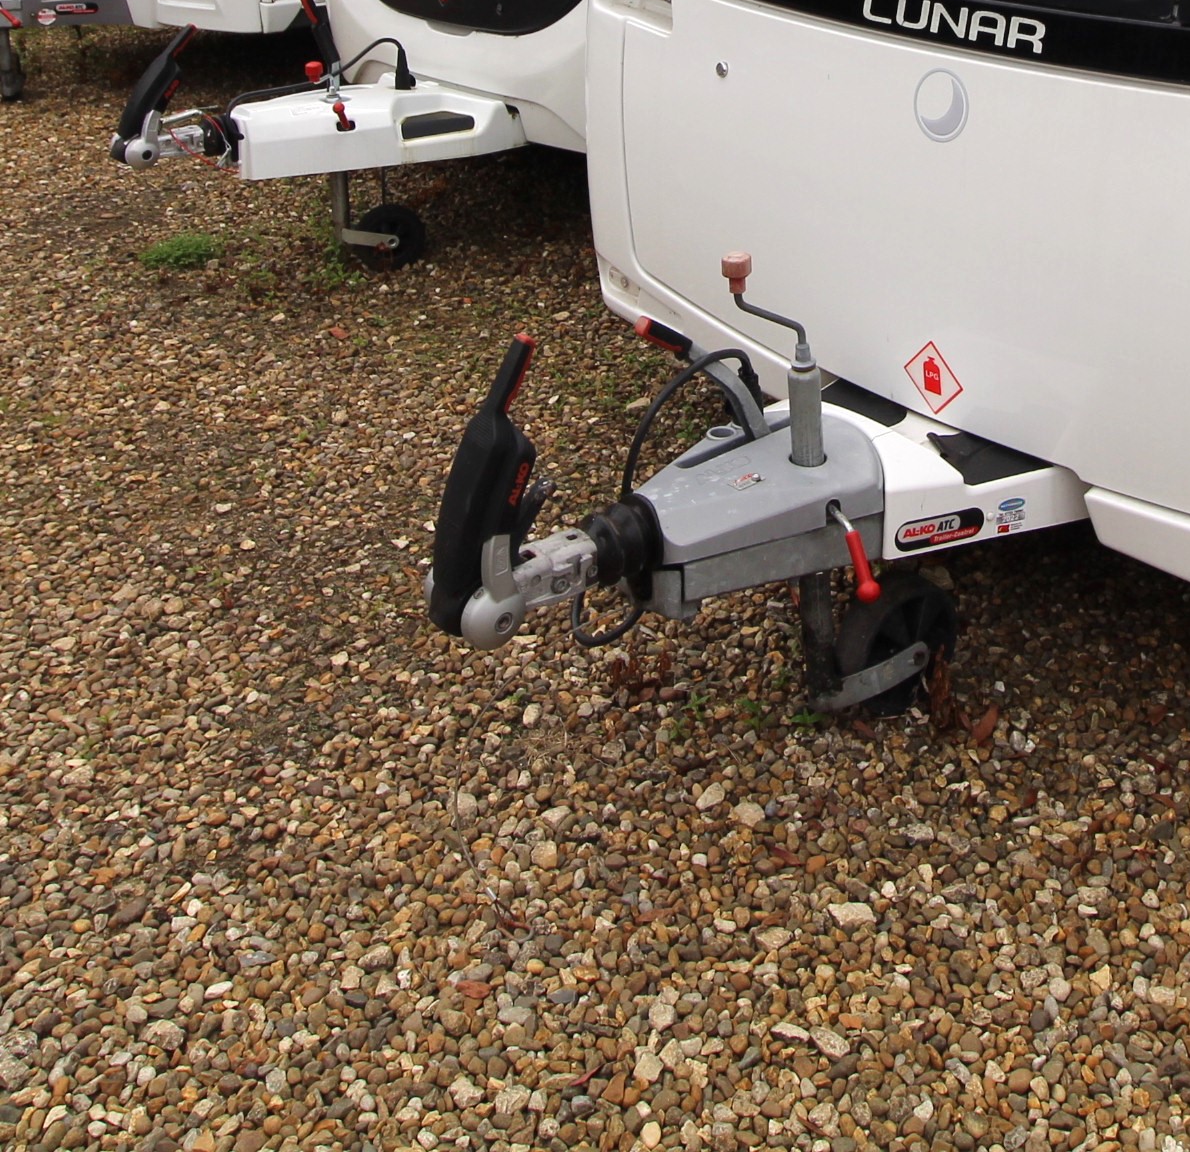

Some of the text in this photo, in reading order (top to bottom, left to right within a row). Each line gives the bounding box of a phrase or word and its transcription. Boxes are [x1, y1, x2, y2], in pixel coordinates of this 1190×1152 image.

[925, 370, 939, 381] LPG
[937, 518, 955, 532] ATC
[1001, 515, 1020, 524] 2022
